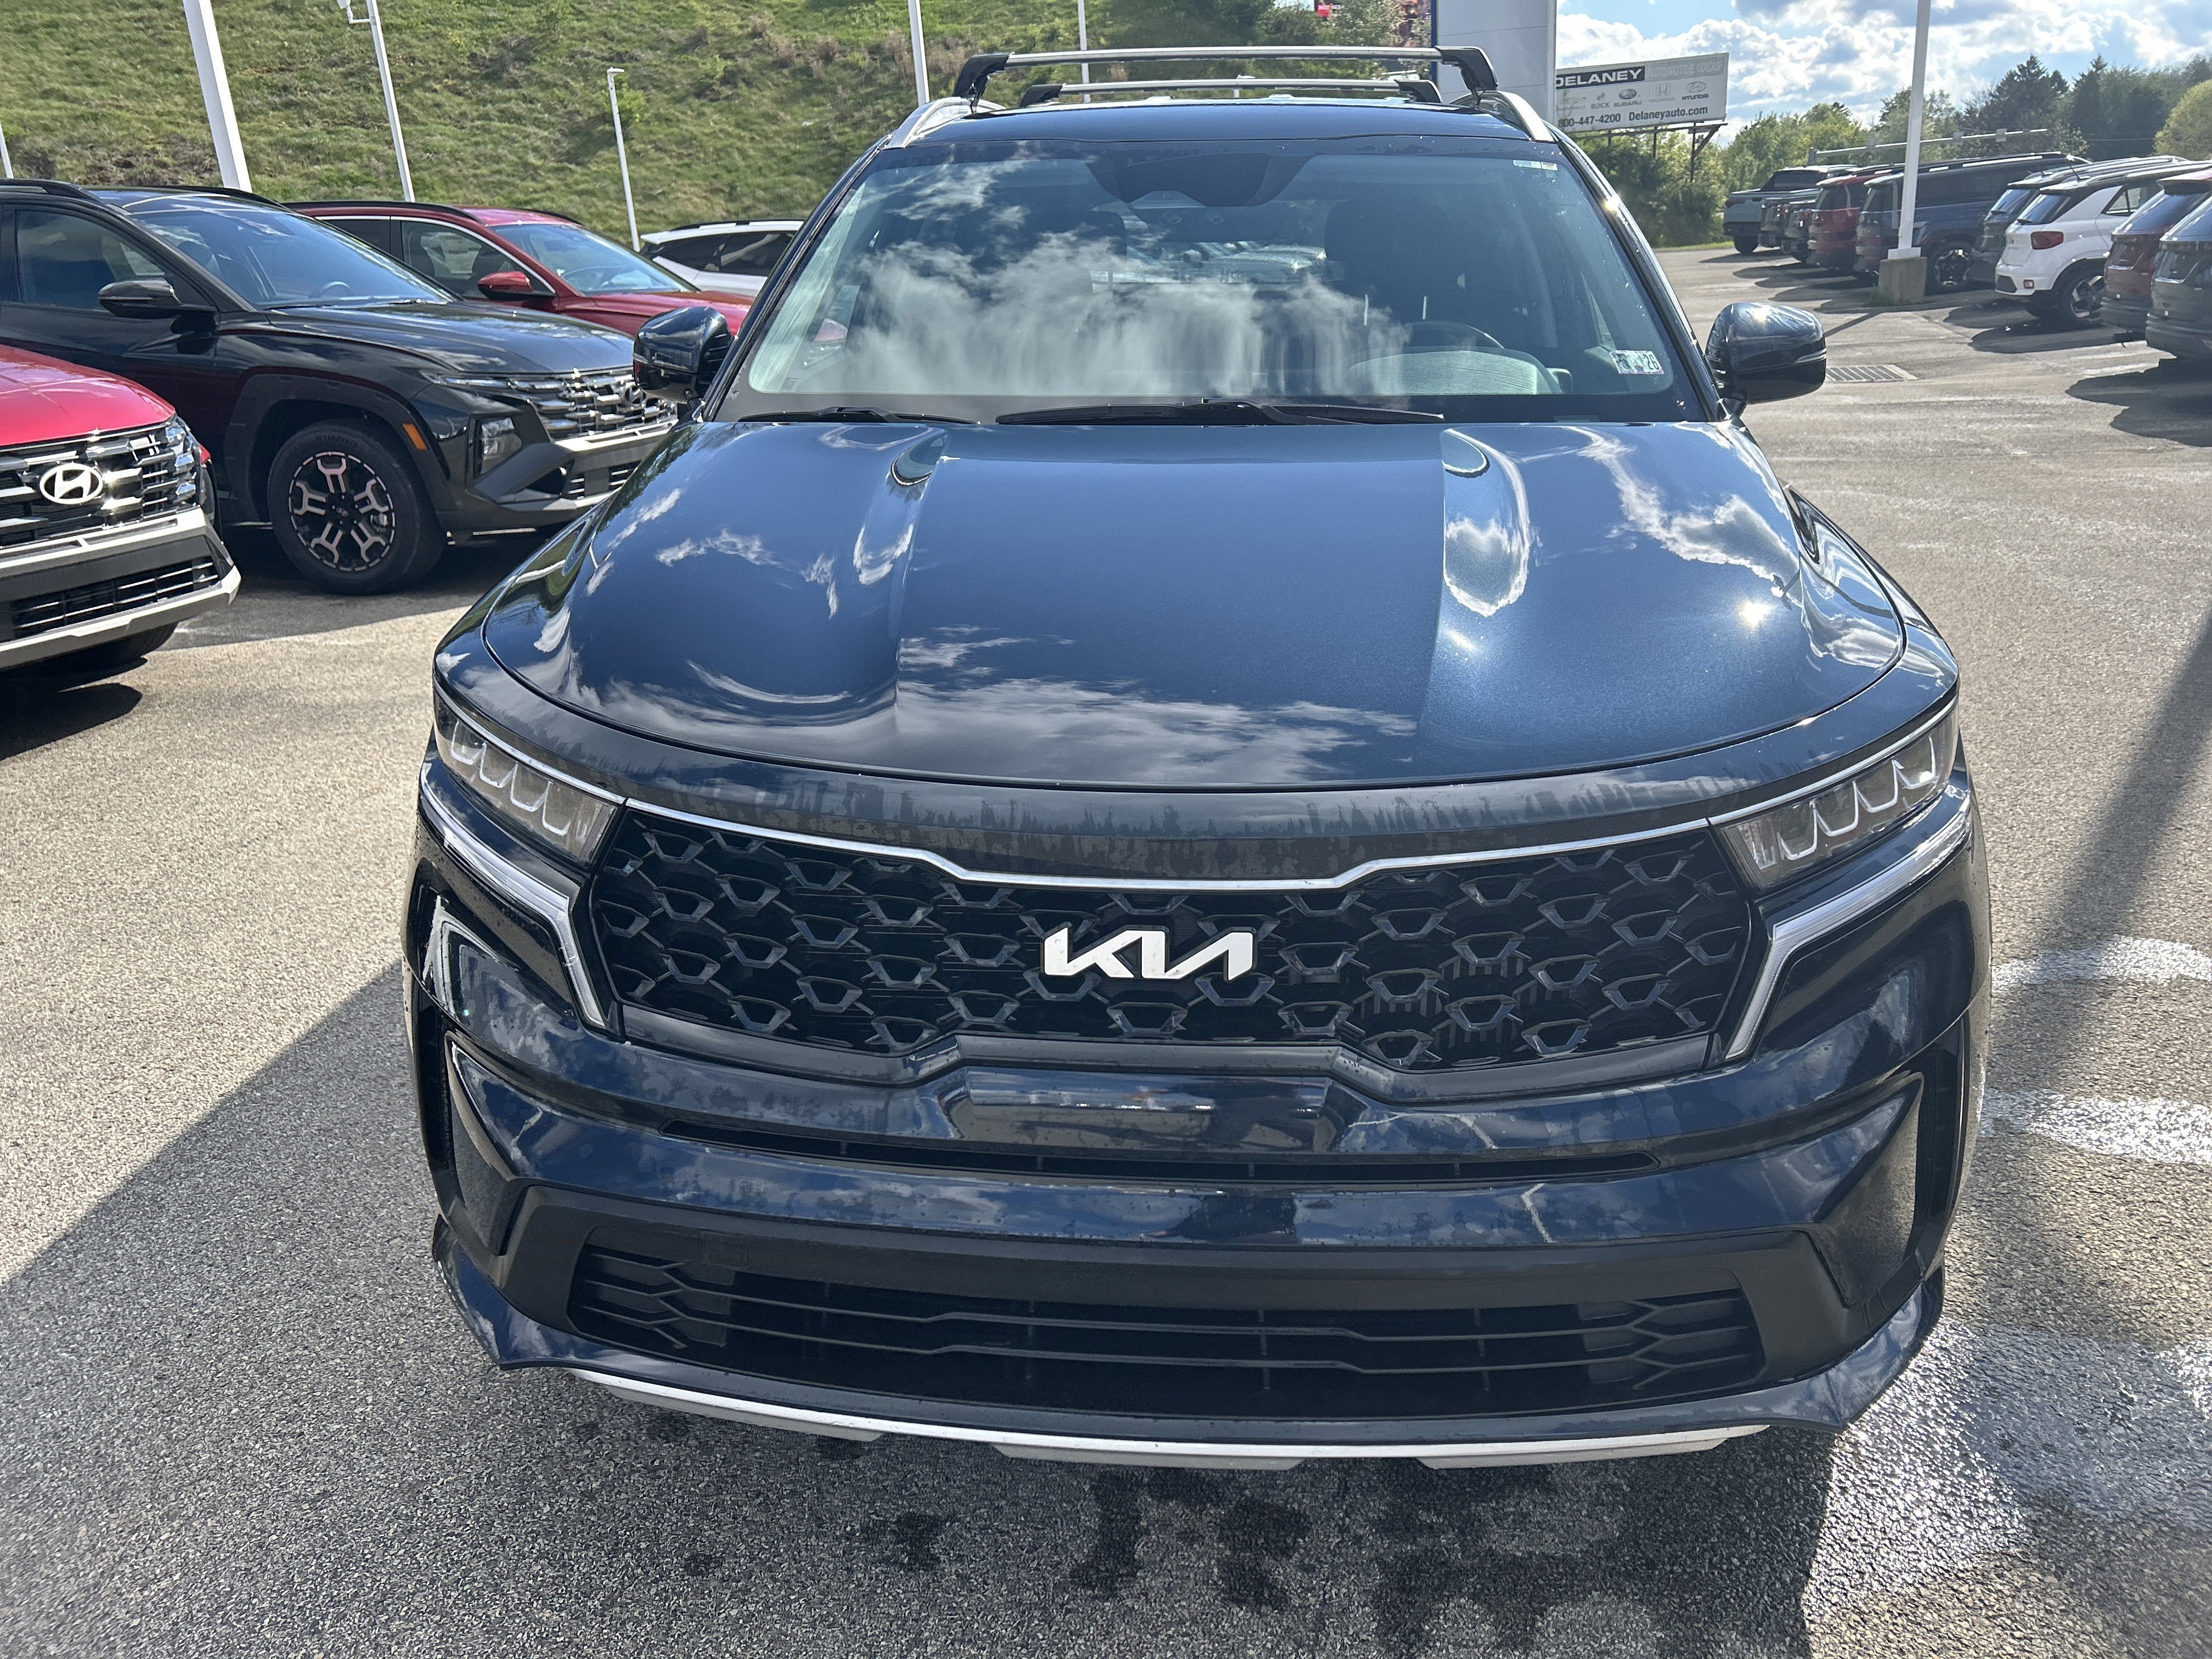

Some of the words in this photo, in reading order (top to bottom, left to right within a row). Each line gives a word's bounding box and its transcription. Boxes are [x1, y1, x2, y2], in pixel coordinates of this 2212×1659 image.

[1556, 69, 1643, 87] DELANEY
[1558, 113, 1621, 128] 800-447-4200
[1628, 106, 1708, 121] Delaneyauto.com
